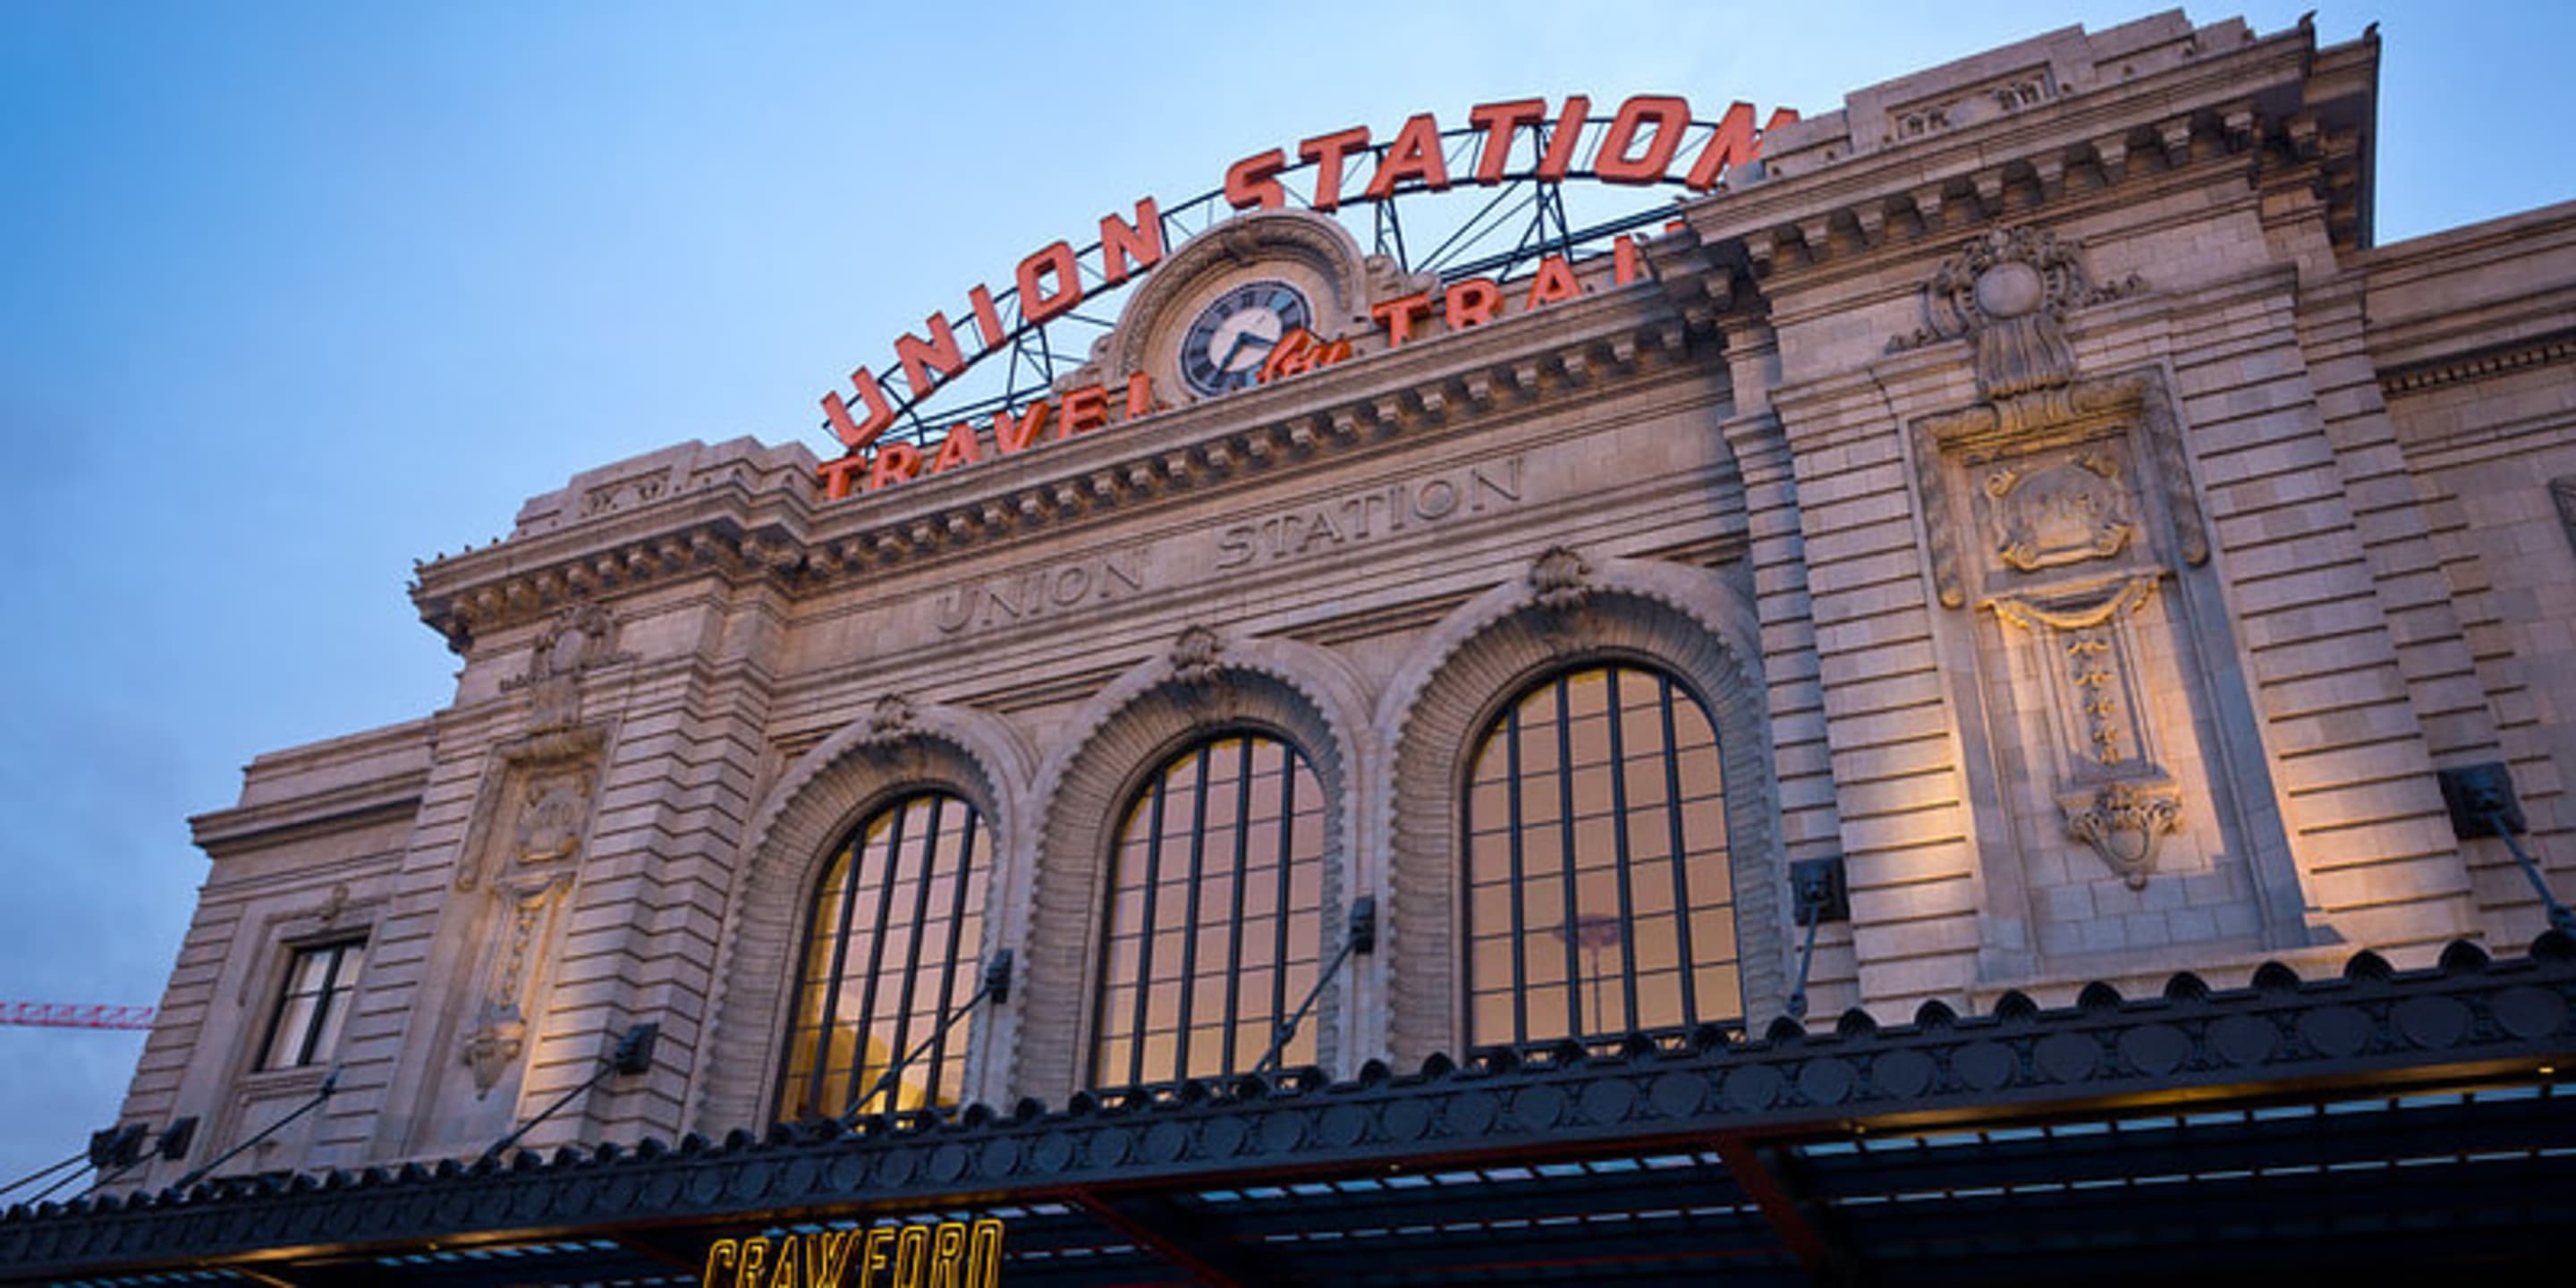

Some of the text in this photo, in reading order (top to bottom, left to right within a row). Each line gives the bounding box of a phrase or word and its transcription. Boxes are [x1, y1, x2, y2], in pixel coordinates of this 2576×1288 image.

[818, 370, 1173, 500] TRAVEL
[1372, 221, 1686, 348] TRAI
[820, 196, 1163, 448] UNION
[1224, 94, 1802, 213] STATION
[936, 457, 1523, 634] UNION STATION
[703, 1219, 1004, 1288] CRAWFORD
